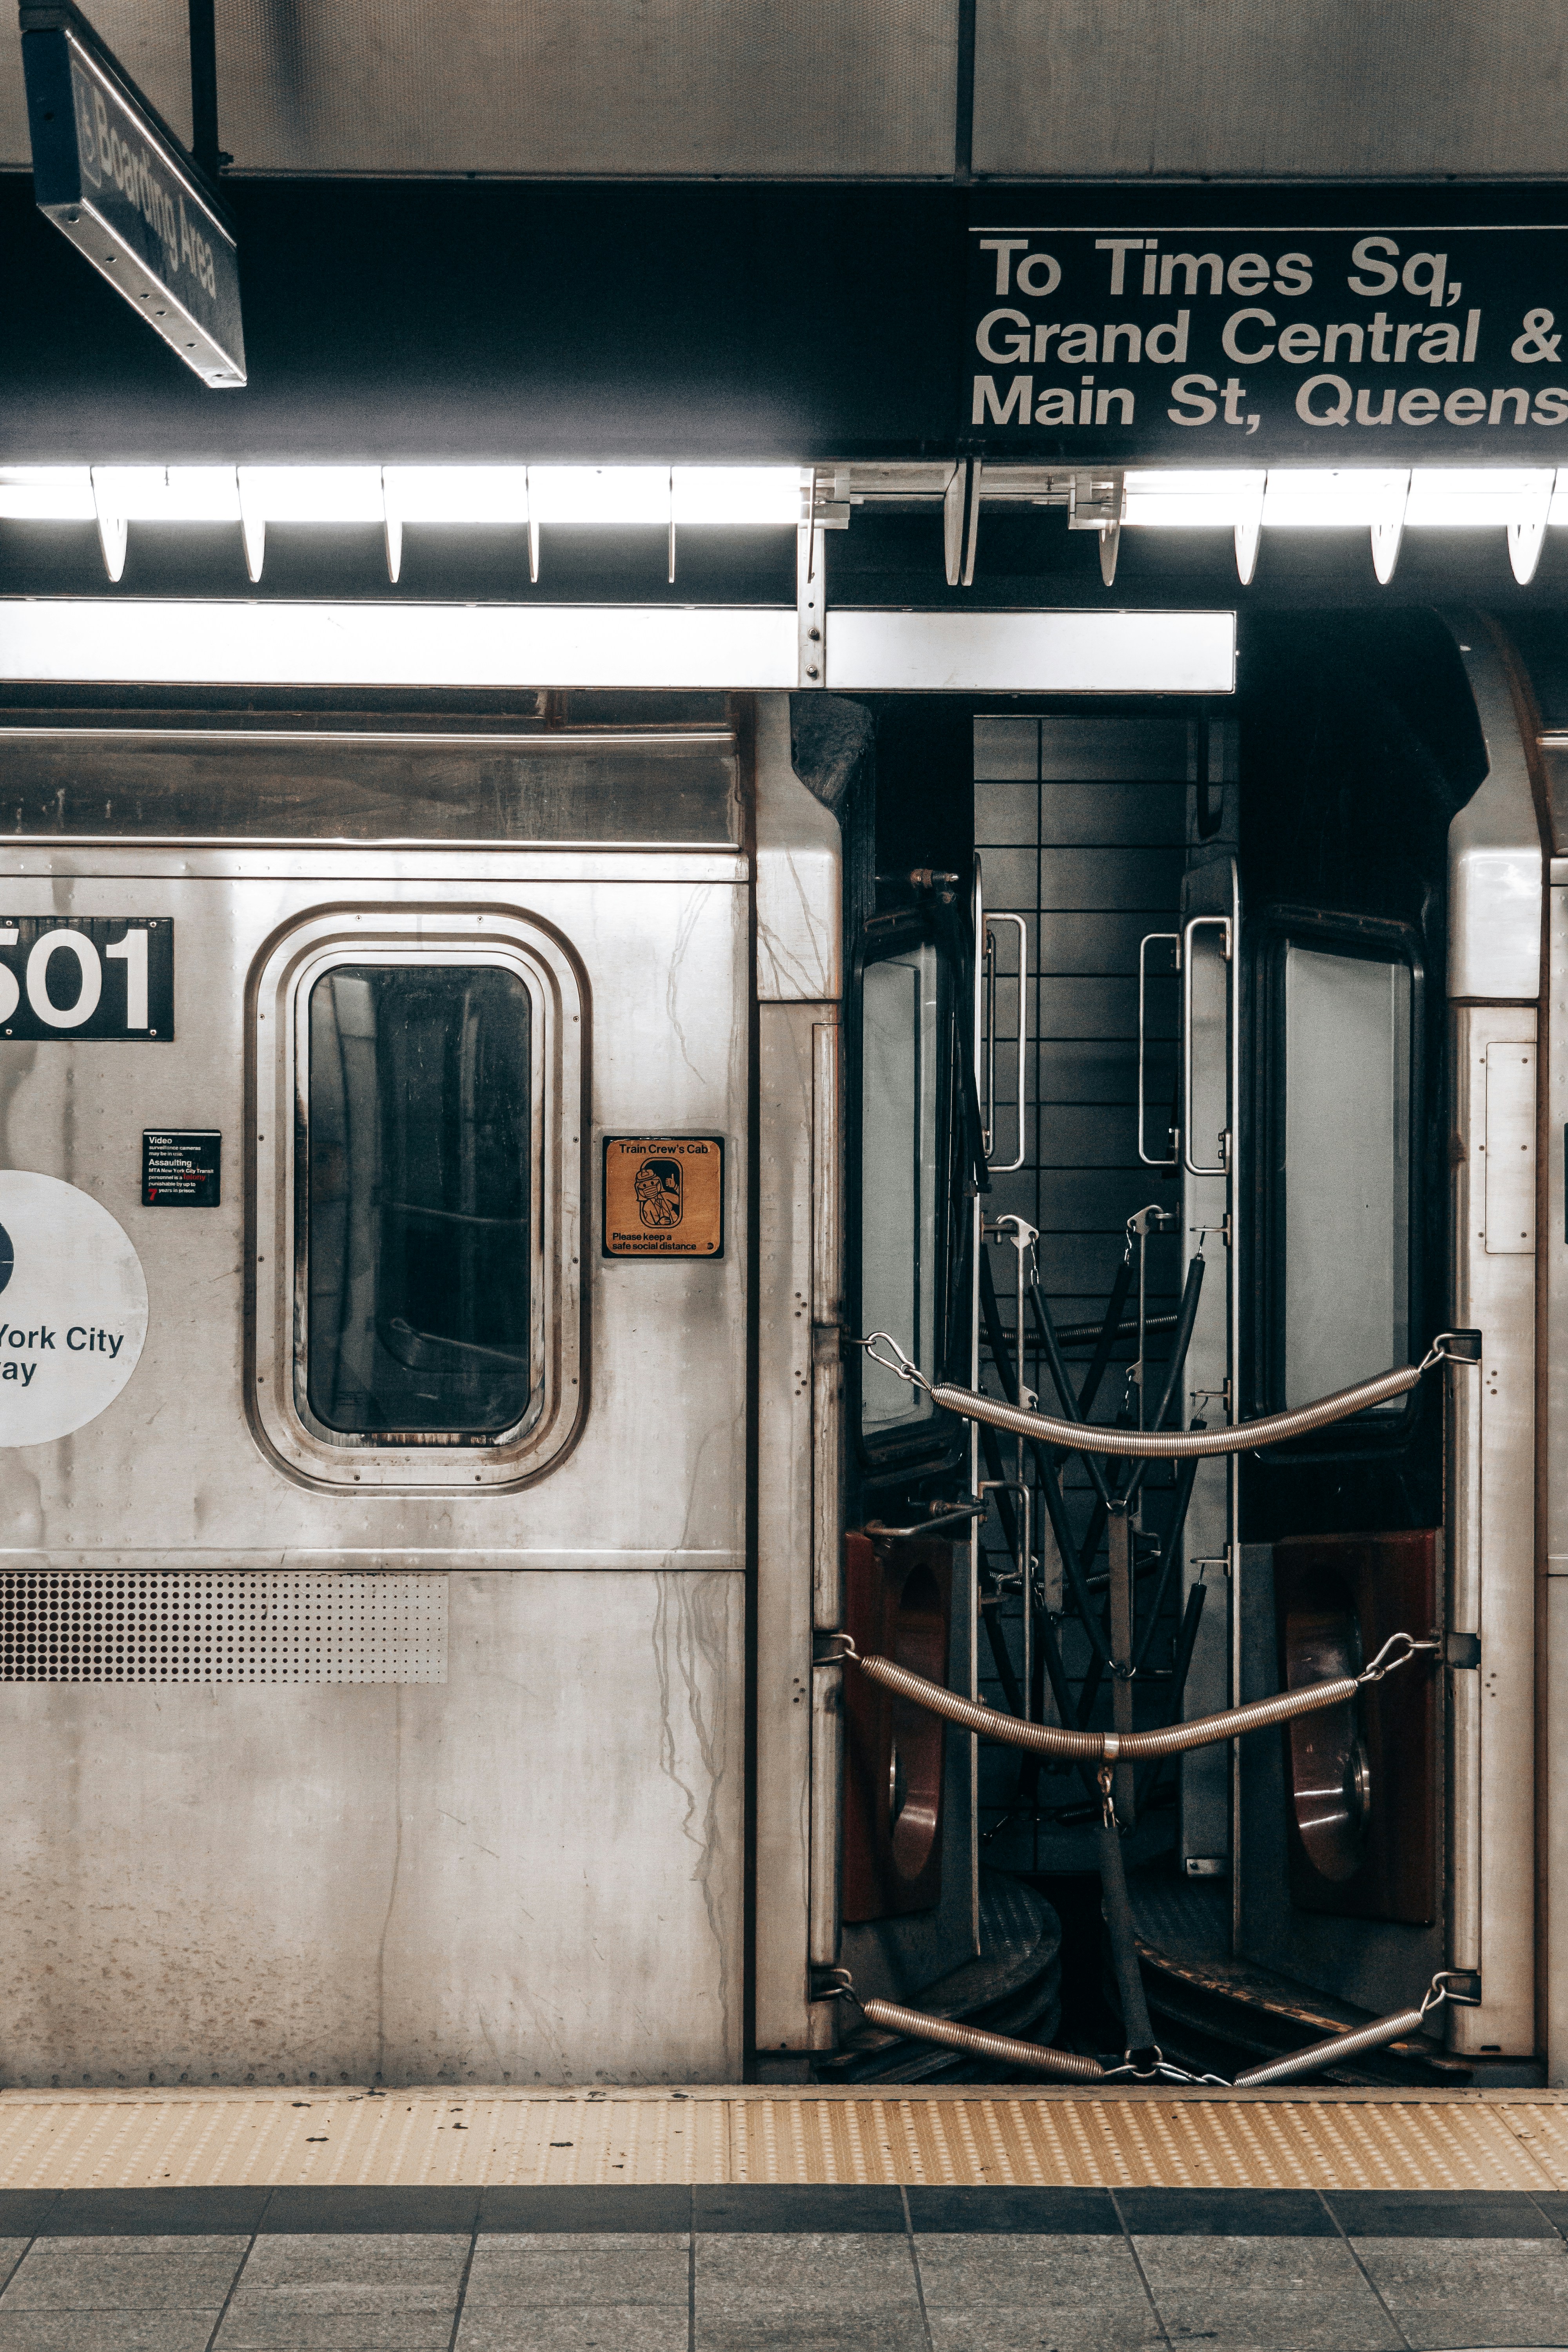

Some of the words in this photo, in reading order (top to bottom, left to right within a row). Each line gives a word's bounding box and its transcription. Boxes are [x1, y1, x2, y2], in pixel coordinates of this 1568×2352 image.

[180, 194, 216, 300] Area
[980, 239, 1062, 296] To
[1095, 238, 1313, 296] Times
[1347, 237, 1462, 307] Sq,
[975, 309, 1190, 364] Grand
[1221, 309, 1481, 364] Central
[1511, 308, 1563, 364] &
[972, 375, 1135, 425] Main
[1167, 374, 1261, 435] St,
[1294, 374, 1568, 427] Queens
[0, 928, 148, 1029] 01
[149, 1159, 192, 1167] Assaulting
[619, 1144, 646, 1154] Train
[648, 1144, 684, 1154] Crew's
[687, 1144, 708, 1154] Cab
[148, 1189, 157, 1201] 7
[612, 1232, 641, 1241] Please
[643, 1233, 665, 1242] keep
[67, 1327, 124, 1358] City
[0, 1362, 37, 1387] ay
